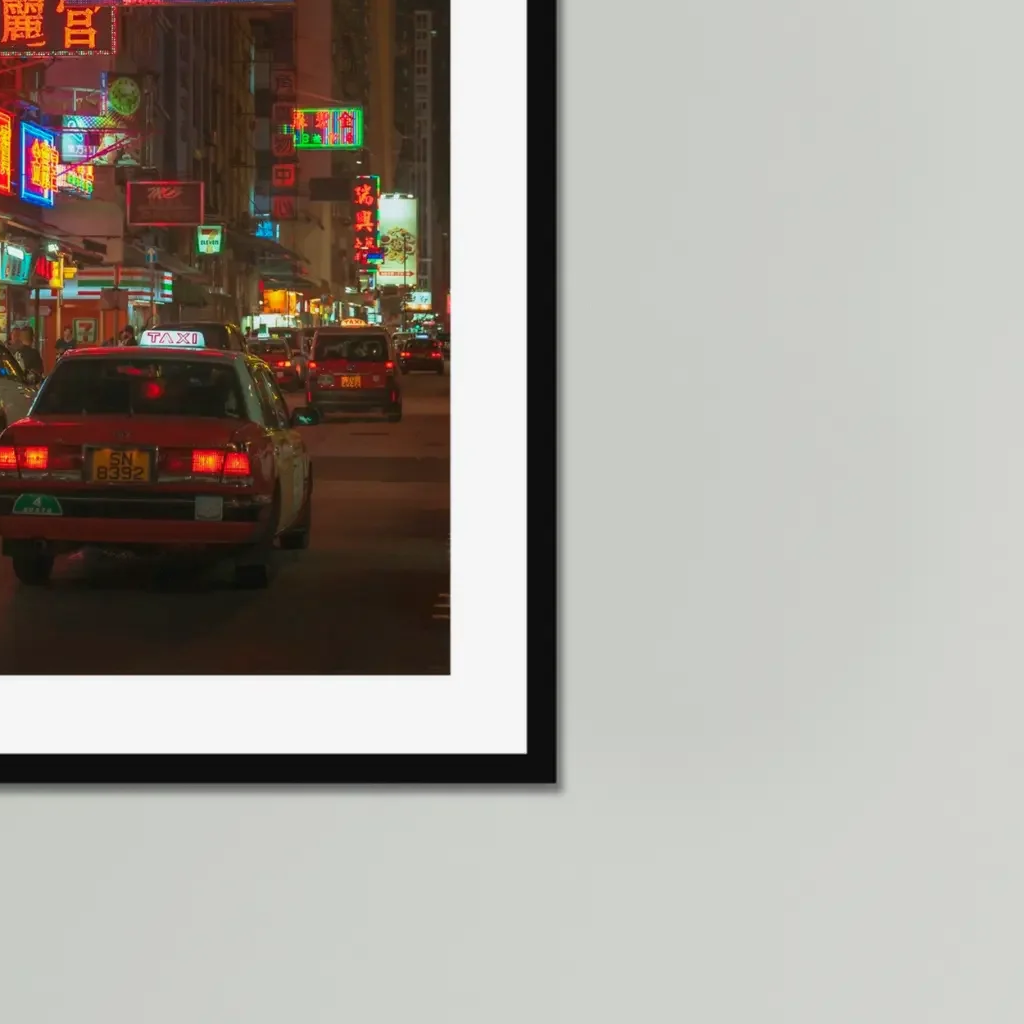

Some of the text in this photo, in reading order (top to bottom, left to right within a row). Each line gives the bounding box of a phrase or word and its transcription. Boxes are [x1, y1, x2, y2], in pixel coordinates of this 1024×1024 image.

[147, 331, 198, 345] TAXI
[110, 452, 133, 466] SN
[97, 466, 144, 480] 8392
